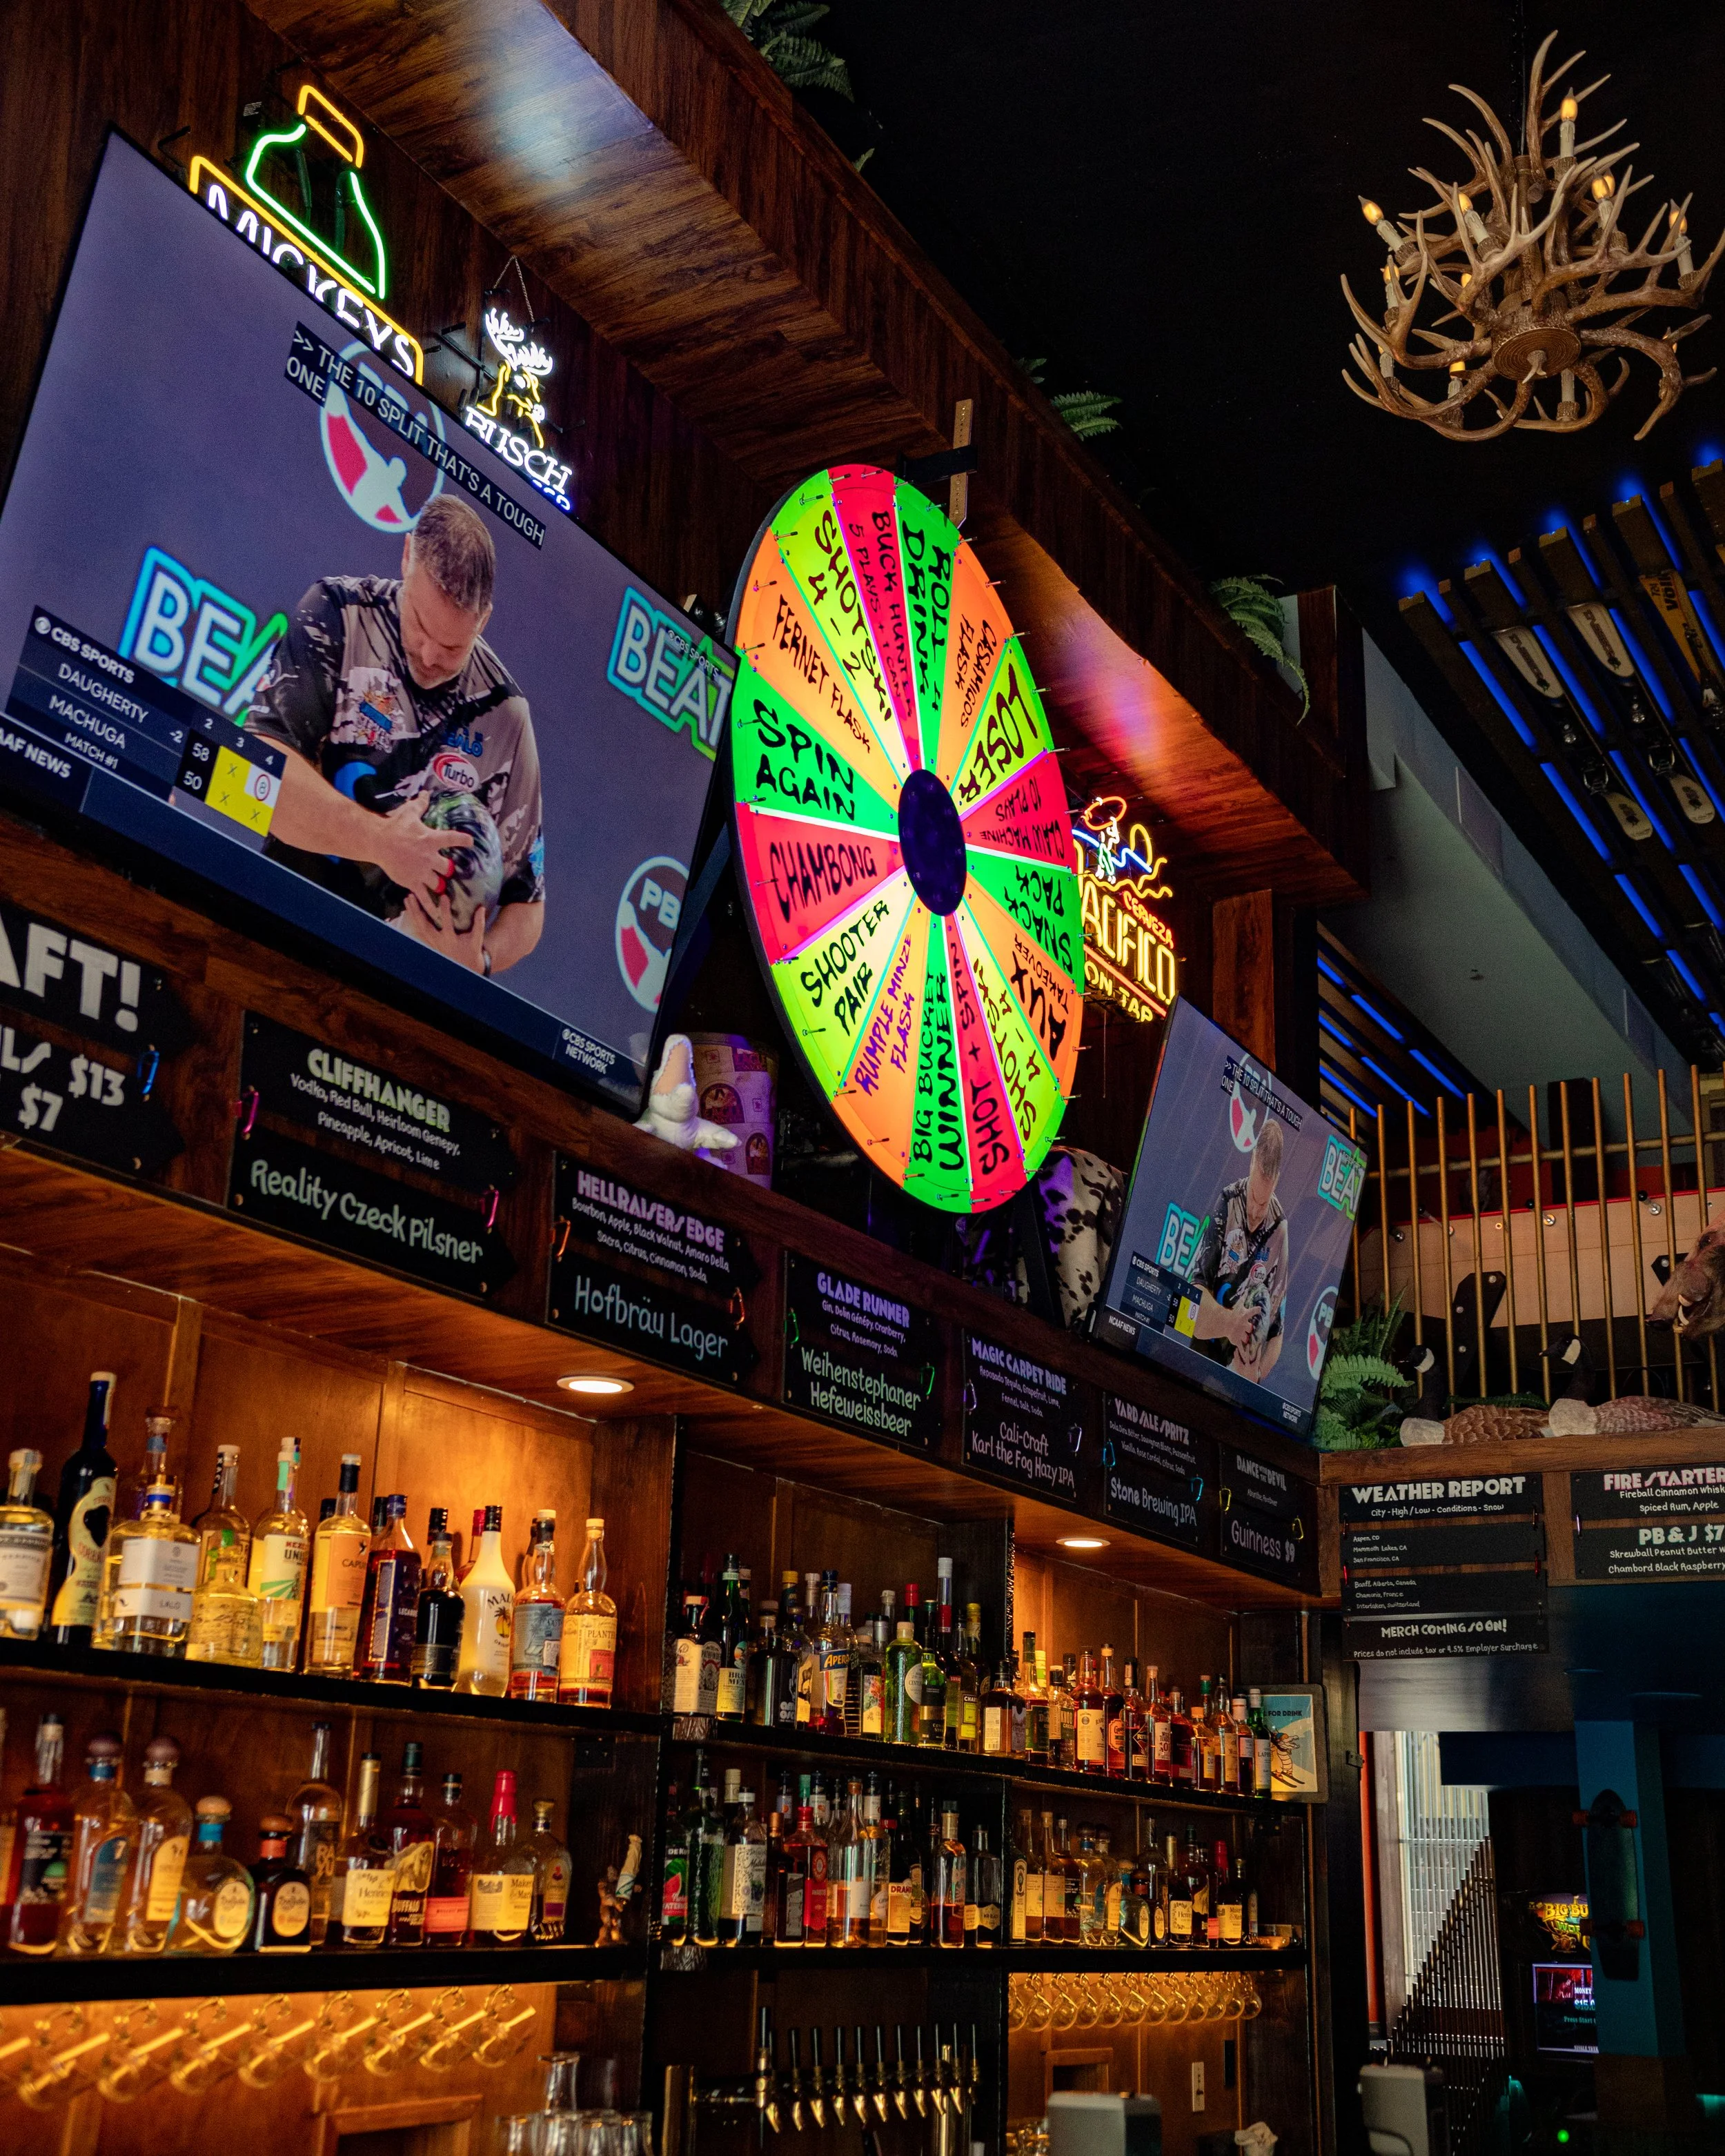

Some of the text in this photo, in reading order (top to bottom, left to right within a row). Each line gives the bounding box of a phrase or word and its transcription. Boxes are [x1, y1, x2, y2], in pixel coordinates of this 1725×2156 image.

[286, 357, 326, 402] ONE.
[319, 346, 545, 546] THE 10 SPLIT THAT'S A TOUGH
[871, 511, 898, 592] BUCK
[809, 573, 860, 680] 4 2
[902, 520, 929, 695] DRINK
[929, 545, 951, 662] ROLL
[51, 626, 135, 684] CBS SPORTS
[773, 594, 871, 753] FERNET FLASK
[960, 620, 997, 727] CASAMIGOS
[58, 663, 210, 761] DAUGHERTY 58
[959, 663, 1038, 802] LOSER
[25, 743, 72, 778] NEWS
[48, 695, 202, 790] MACHUGA 50
[66, 732, 119, 769] MATCH #1
[204, 718, 273, 765] 2 3 4
[753, 699, 855, 793] SPIN
[444, 764, 474, 789] Turbo
[756, 754, 855, 820] AGAIN
[770, 842, 878, 922] CHAMBONG
[1016, 865, 1064, 916] PACK
[801, 900, 889, 1007] SHOOTER
[1005, 887, 1072, 974] SNACK
[835, 962, 873, 1036] PAIR
[855, 933, 911, 1096] RUMPLE MINZE
[1084, 960, 1154, 1022] ON TAP
[565, 1044, 608, 1074] NETWORK
[569, 1033, 615, 1065] CBS SPORTS
[891, 992, 915, 1073] FLASK
[951, 942, 1009, 1174] SHOT SPIN
[68, 1054, 125, 1105] $13
[308, 1048, 451, 1133] CLIFFHANGER
[913, 971, 934, 1163] BIG BUCKET
[936, 972, 964, 1170] WINNER
[1232, 1063, 1303, 1127] THE SPLIT TOUGH
[18, 1082, 63, 1132] $7
[290, 1073, 421, 1139] Vodka, Red Bull, Heirloom
[317, 1111, 440, 1170] Pineapple, Apricot, Lime
[250, 1159, 483, 1263] Reality Czeck Pilsner
[578, 1170, 724, 1252] HELLRAISERS EDGE
[608, 1214, 709, 1263] Apple, Black Amaro
[597, 1229, 649, 1263] Sacra, Citrus,
[575, 1275, 728, 1361] Hofbräu Lager
[818, 1272, 909, 1328] GLADE RUNNER
[836, 1305, 906, 1344] Dolin Cranberry,
[801, 1347, 921, 1411] Weihenstephaner
[972, 1337, 1067, 1395] MAGIC CARPET RIDE
[810, 1381, 912, 1436] Hefeweissbeer
[1114, 1398, 1190, 1446] YARD SALE SPRITZ
[972, 1430, 1075, 1489] Karl the Fog Hazy IPA
[1000, 1421, 1049, 1456] Cali-Craft
[1236, 1454, 1260, 1480] DANCE
[1110, 1476, 1197, 1526] Stone Brewing IPA
[1268, 1469, 1287, 1492] DEVIL
[1351, 1476, 1526, 1504] WEATHER REPORT
[1604, 1473, 1642, 1491] FIRE
[1619, 1487, 1699, 1499] Fireball Cinnamon
[1639, 1501, 1719, 1514] Spiced Rum, Apple
[1371, 1508, 1386, 1518] City
[1392, 1506, 1408, 1518] High
[1437, 1504, 1478, 1514] Conditions
[1483, 1503, 1504, 1512] Snow
[1638, 1525, 1697, 1546] PB & J
[1230, 1520, 1281, 1560] Guinness
[1608, 1561, 1679, 1574] Chambord Black
[1610, 1548, 1653, 1559] Skrewball
[1654, 1548, 1686, 1556] Peanut
[1354, 1650, 1374, 1659] Prices
[1399, 1646, 1424, 1656] include
[1466, 1644, 1499, 1656] Employer
[1500, 1641, 1539, 1651] Surcharge
[1381, 1619, 1507, 1639] MERCH COMING SOON!
[1544, 1903, 1569, 1918] BIG
